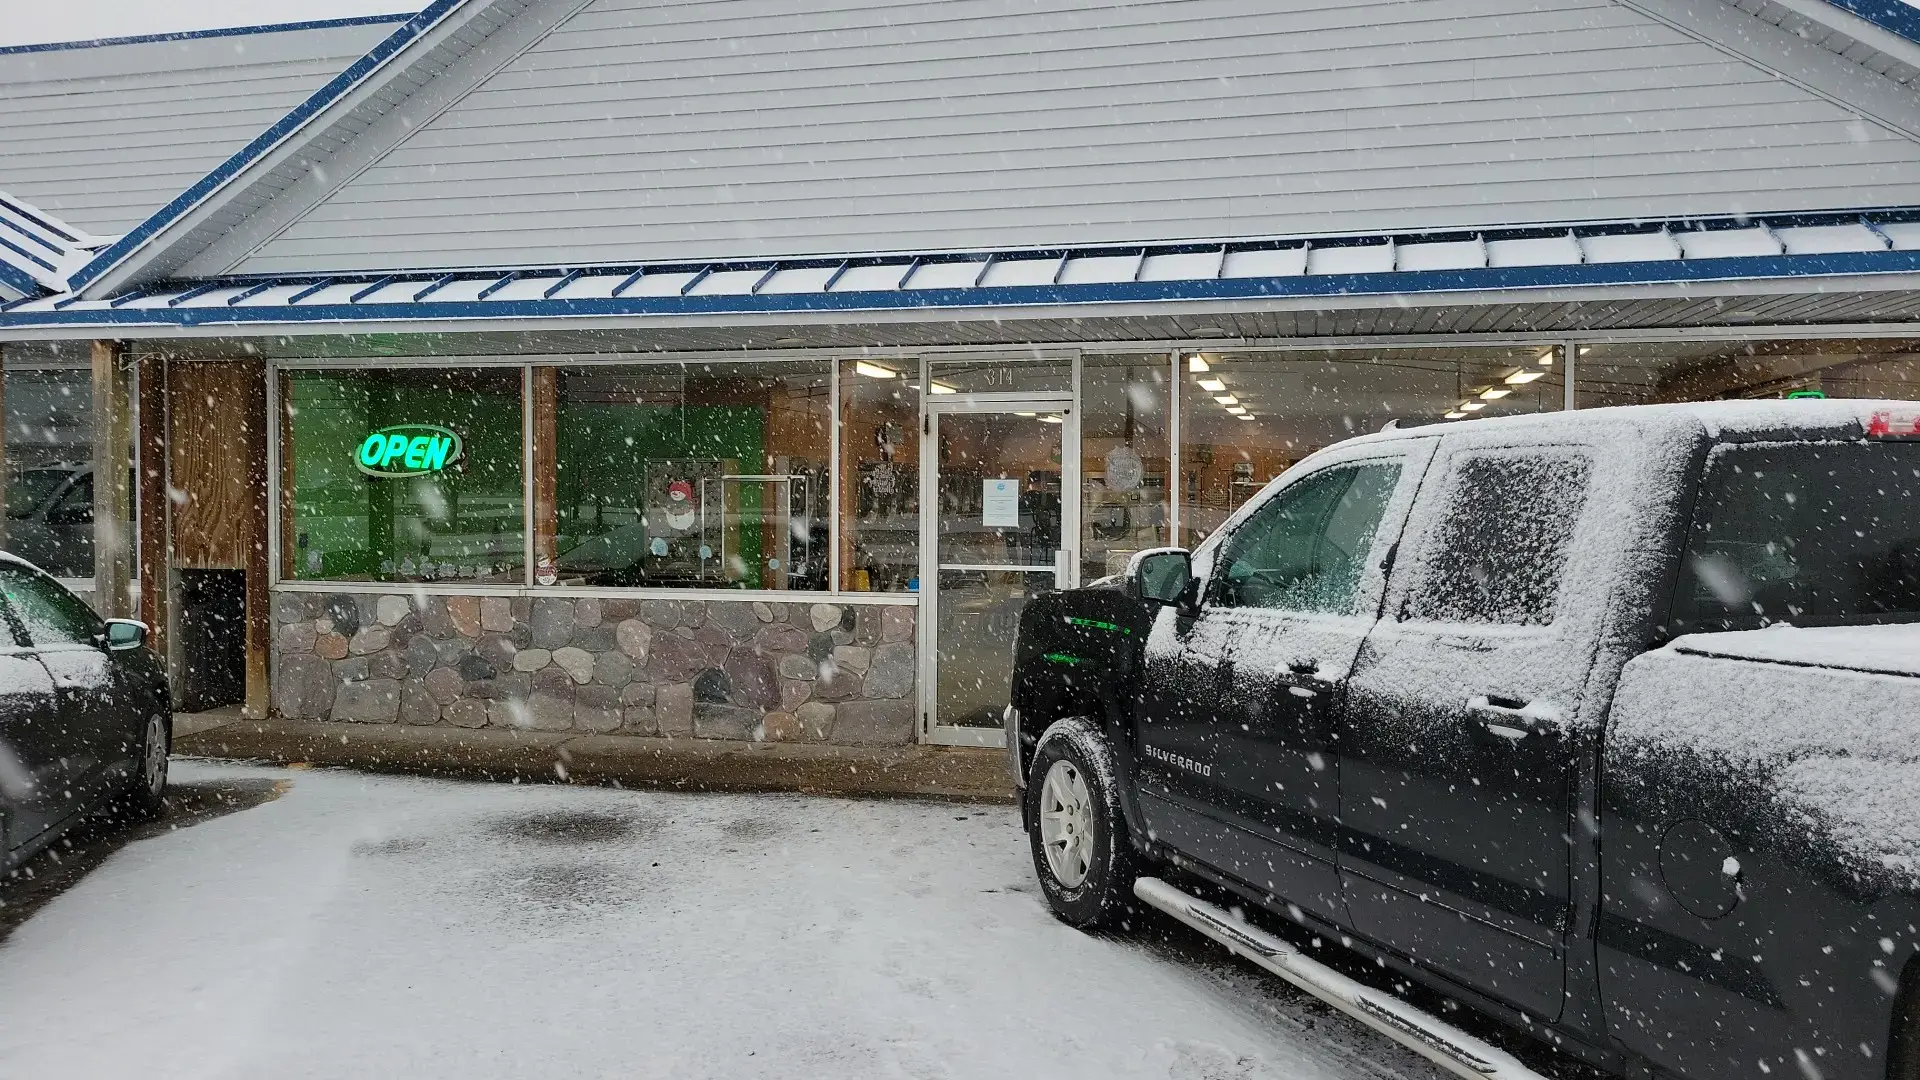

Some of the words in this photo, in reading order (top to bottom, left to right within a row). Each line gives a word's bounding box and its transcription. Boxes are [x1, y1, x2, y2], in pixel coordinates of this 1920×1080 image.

[986, 368, 1013, 386] 314
[360, 433, 452, 470] OPEN
[1145, 744, 1211, 777] SILVERADO
